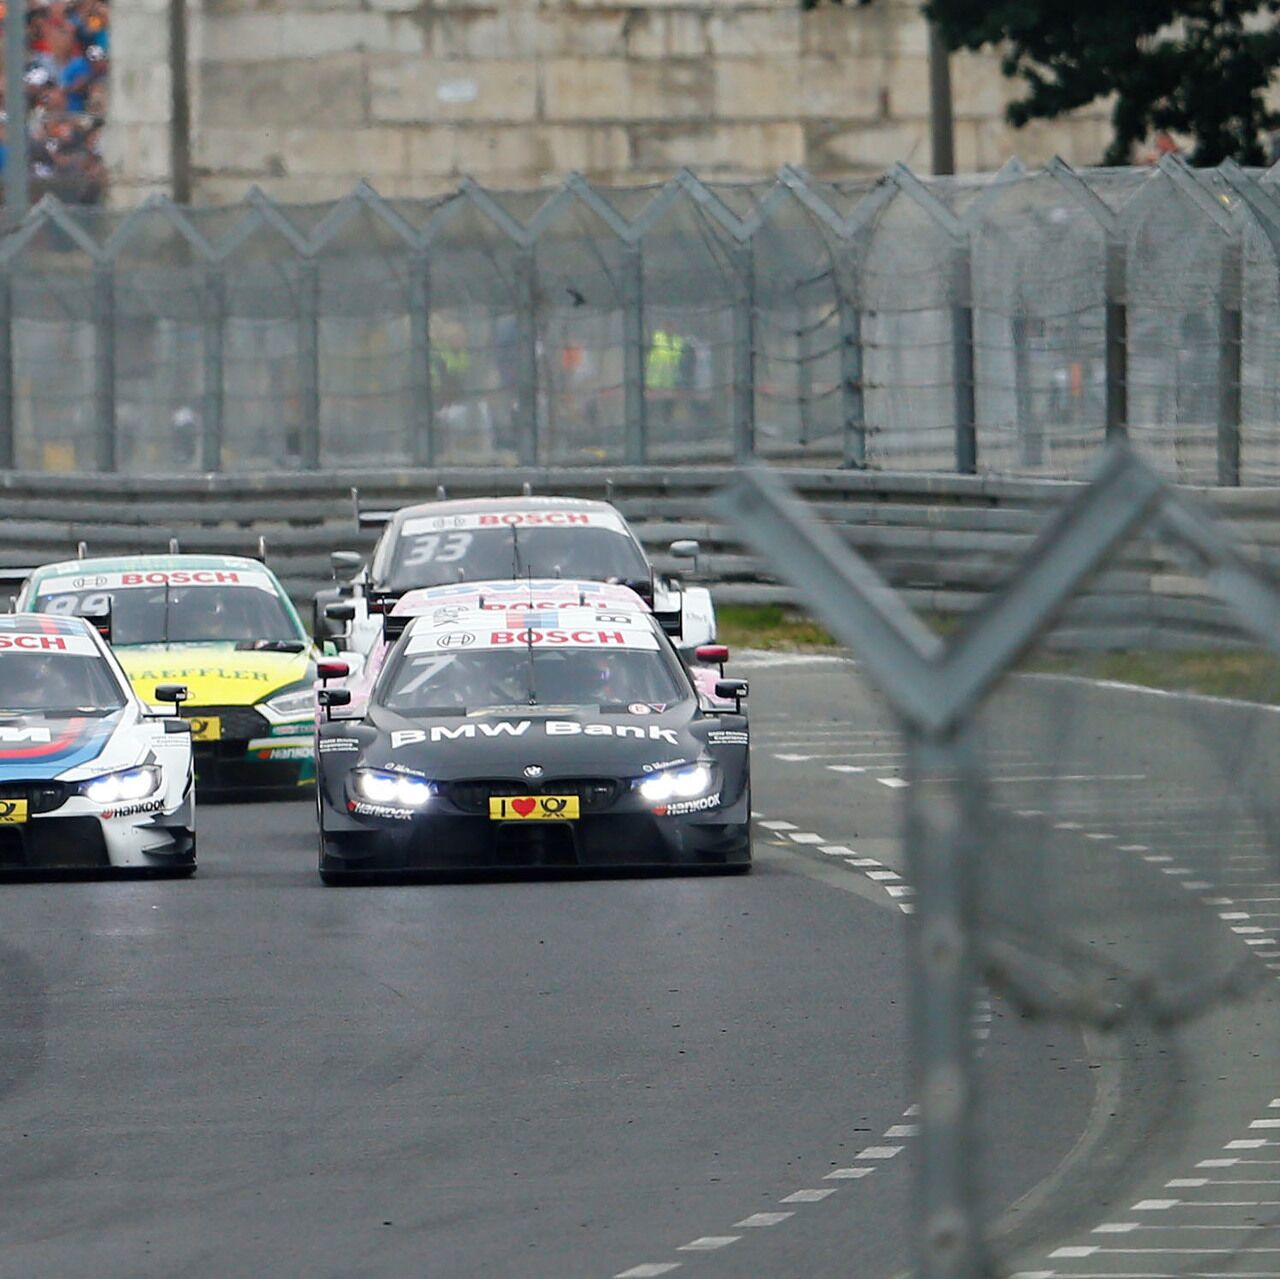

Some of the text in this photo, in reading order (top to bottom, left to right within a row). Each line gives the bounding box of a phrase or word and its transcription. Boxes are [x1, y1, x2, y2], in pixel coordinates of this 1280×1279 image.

[478, 513, 589, 526] BOSCH
[403, 531, 473, 567] 33
[120, 572, 240, 586] BOSCH
[490, 630, 625, 645] BOSCH
[397, 654, 457, 695] 7
[391, 720, 679, 749] BMW Bank
